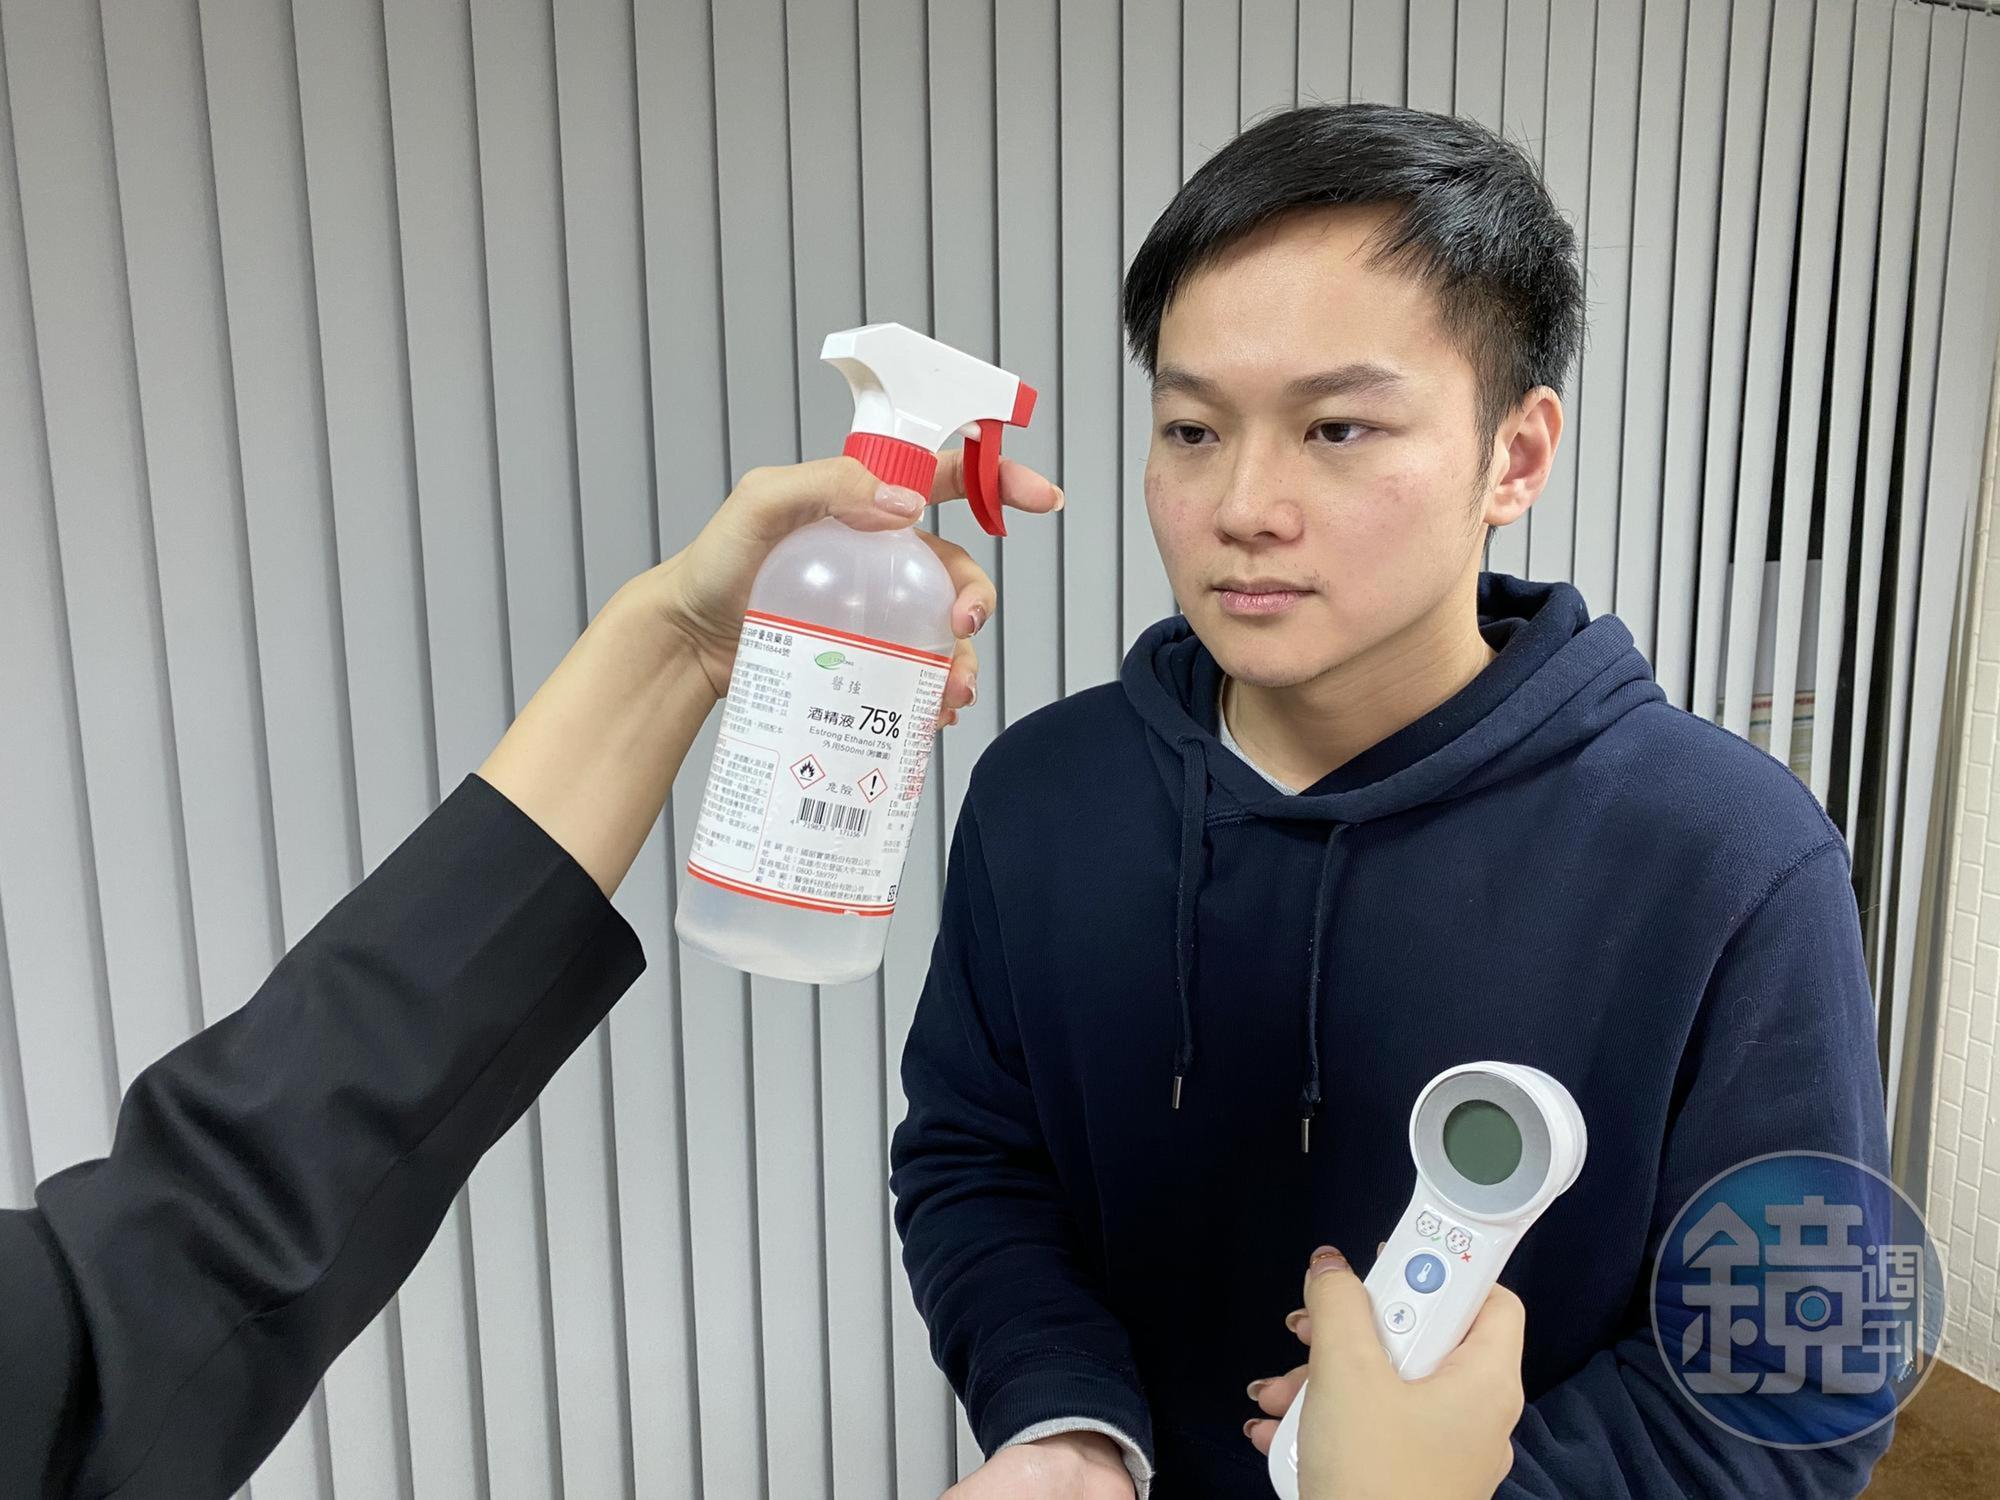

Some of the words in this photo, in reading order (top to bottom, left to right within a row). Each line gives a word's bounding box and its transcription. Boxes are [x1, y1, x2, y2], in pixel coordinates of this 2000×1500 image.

[807, 706, 855, 728] 酒精液
[859, 705, 902, 739] 75%
[809, 725, 842, 741] Estrong
[844, 734, 875, 748] Ethanol
[876, 740, 892, 750] 75%
